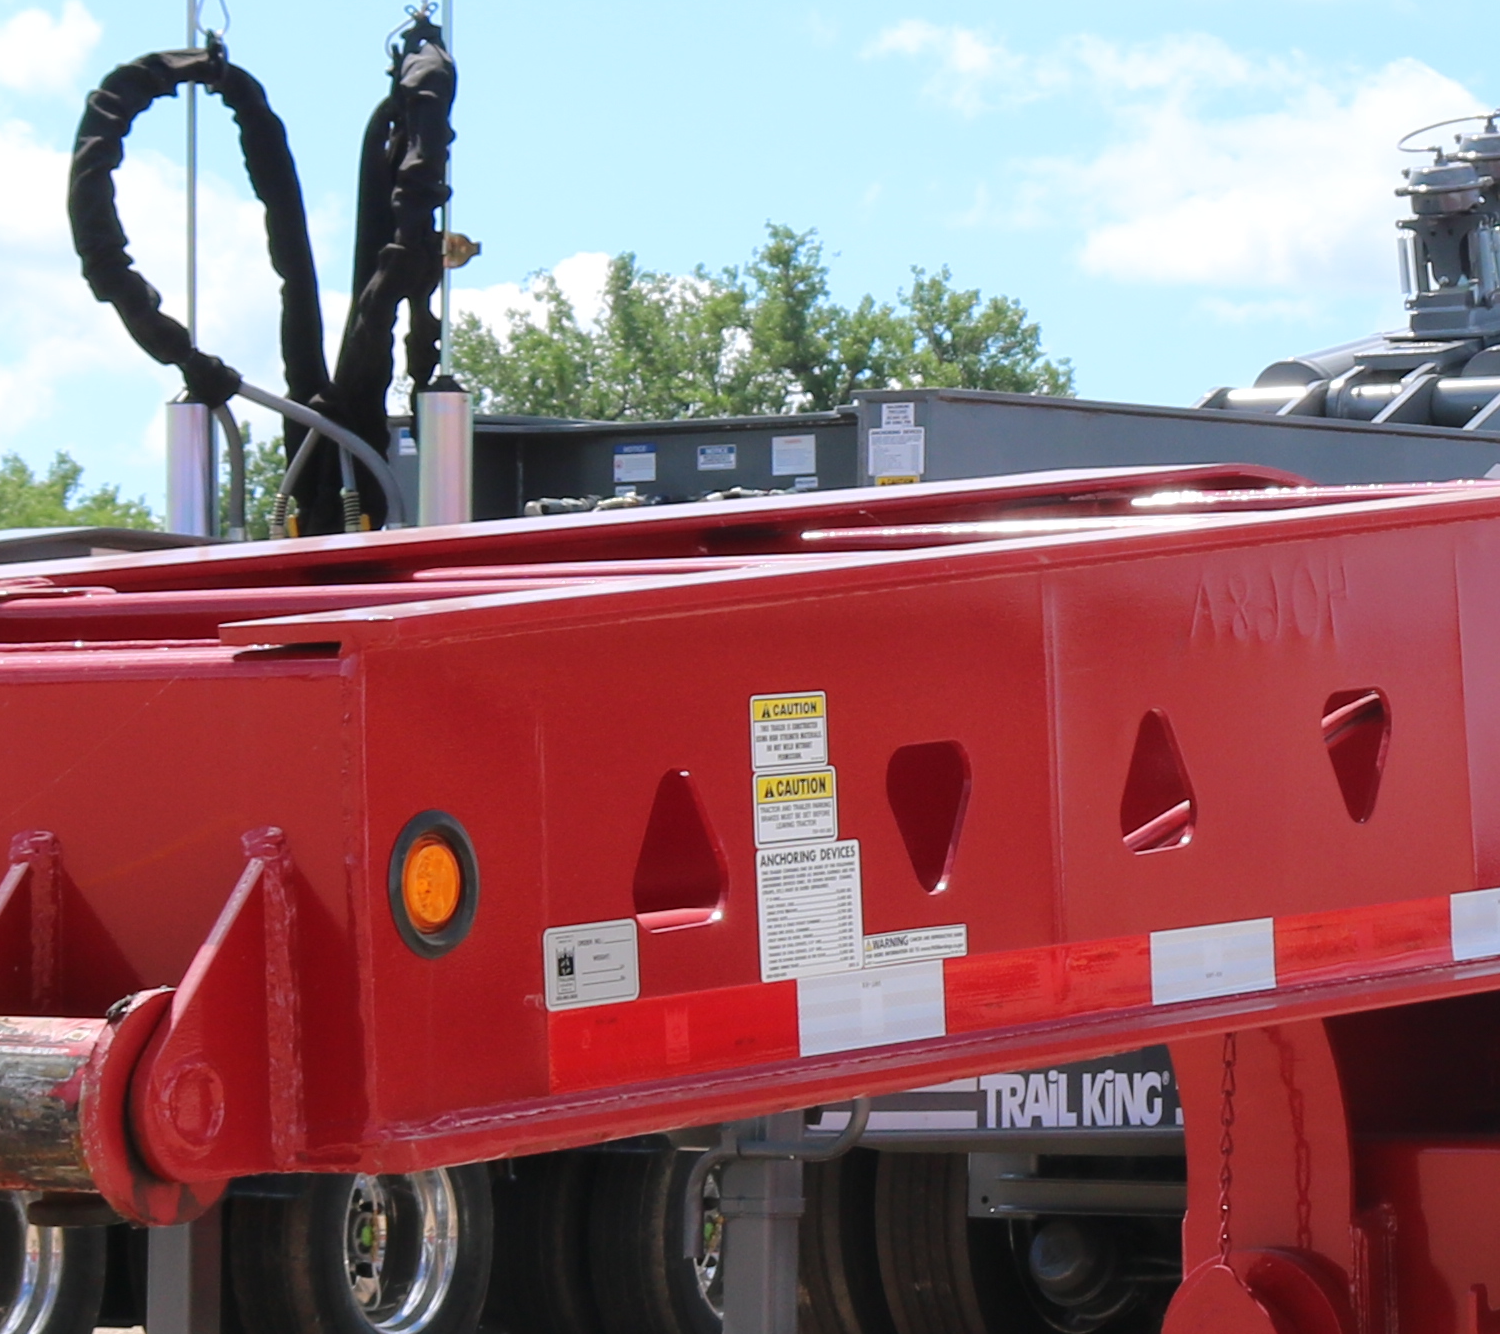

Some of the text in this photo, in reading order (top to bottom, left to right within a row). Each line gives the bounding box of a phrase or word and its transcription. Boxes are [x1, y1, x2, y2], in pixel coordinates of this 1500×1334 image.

[773, 701, 817, 716] CAUTION
[776, 776, 826, 797] CAUTION
[760, 845, 856, 867] ANCHORING DEVICES
[872, 935, 909, 949] WARNING
